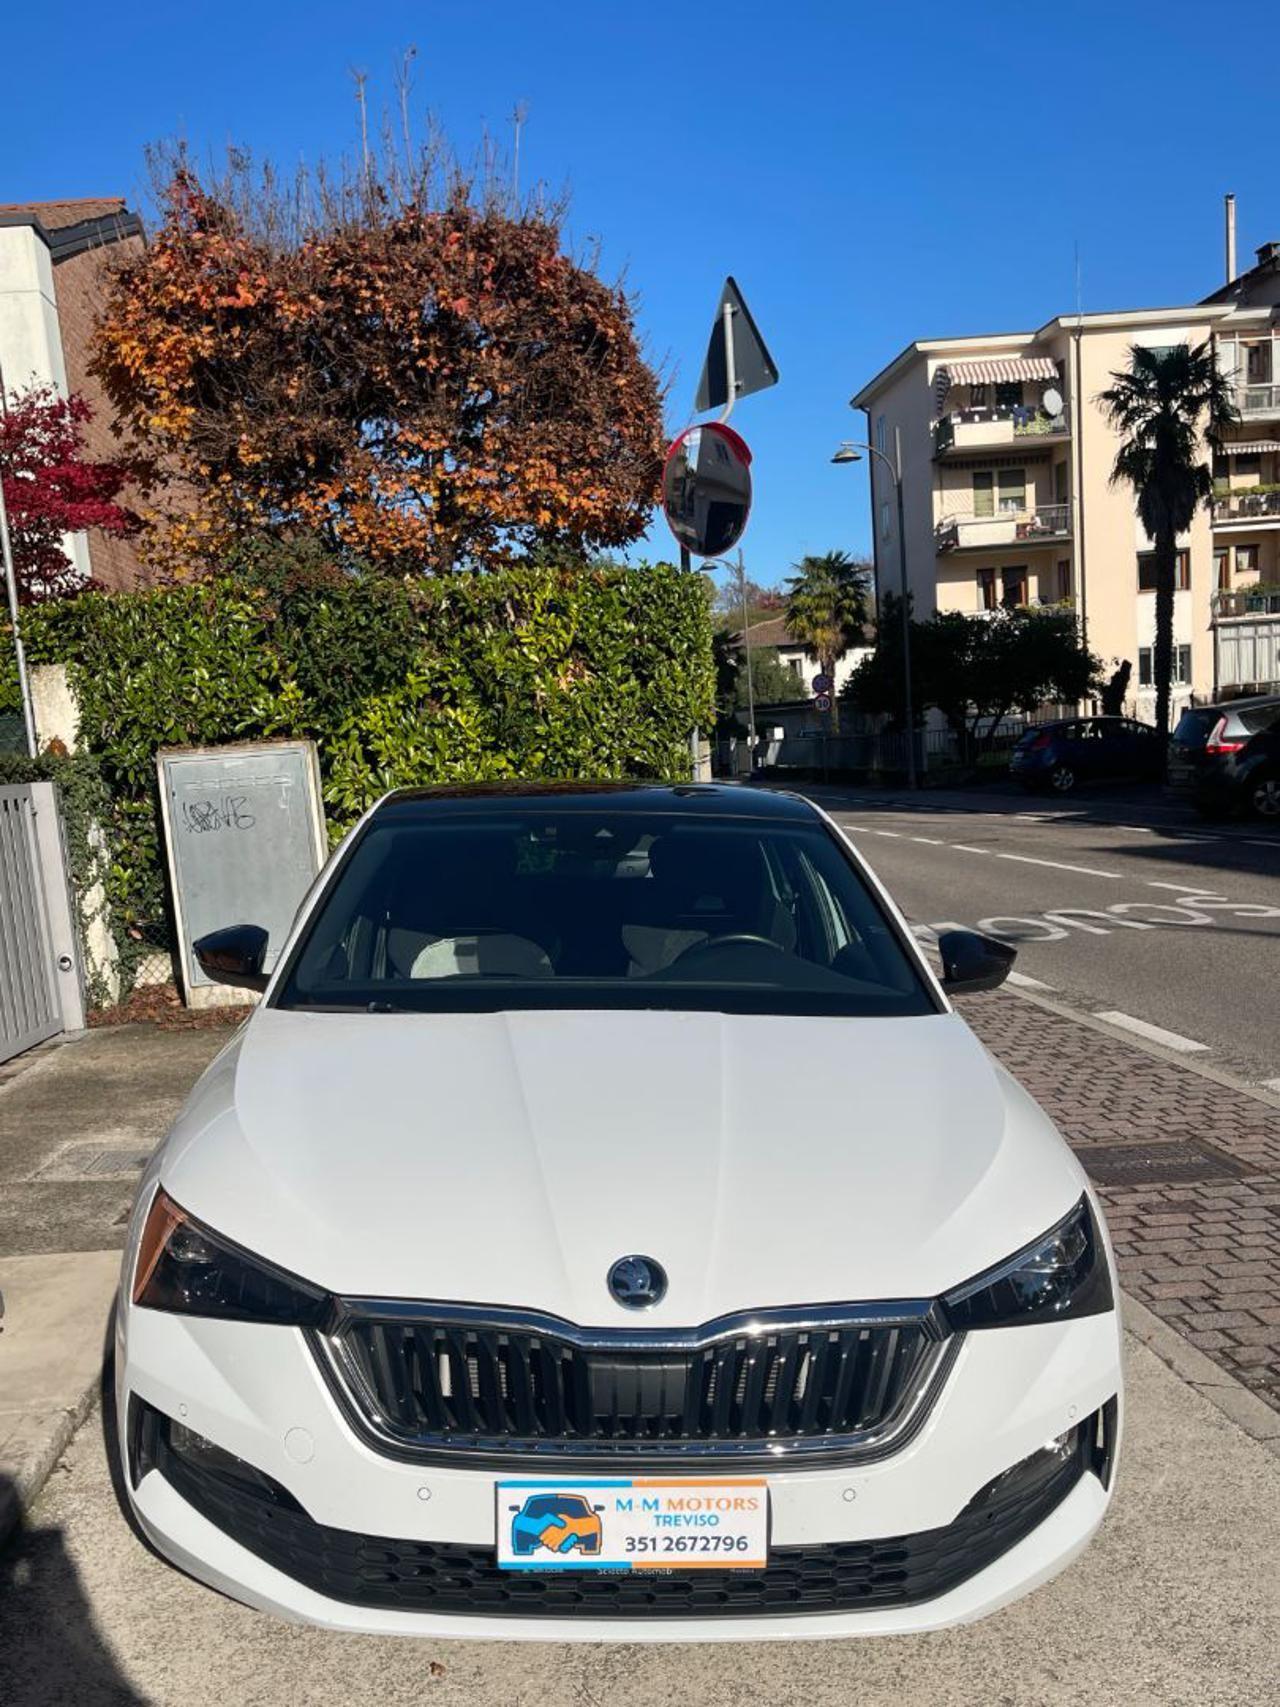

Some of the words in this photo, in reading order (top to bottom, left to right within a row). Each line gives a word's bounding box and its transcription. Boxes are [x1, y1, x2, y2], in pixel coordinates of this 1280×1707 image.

[667, 1498, 759, 1511] MOTORS
[654, 1515, 720, 1527] TREVISO
[624, 1536, 657, 1552] 351
[662, 1536, 749, 1552] 2672796
